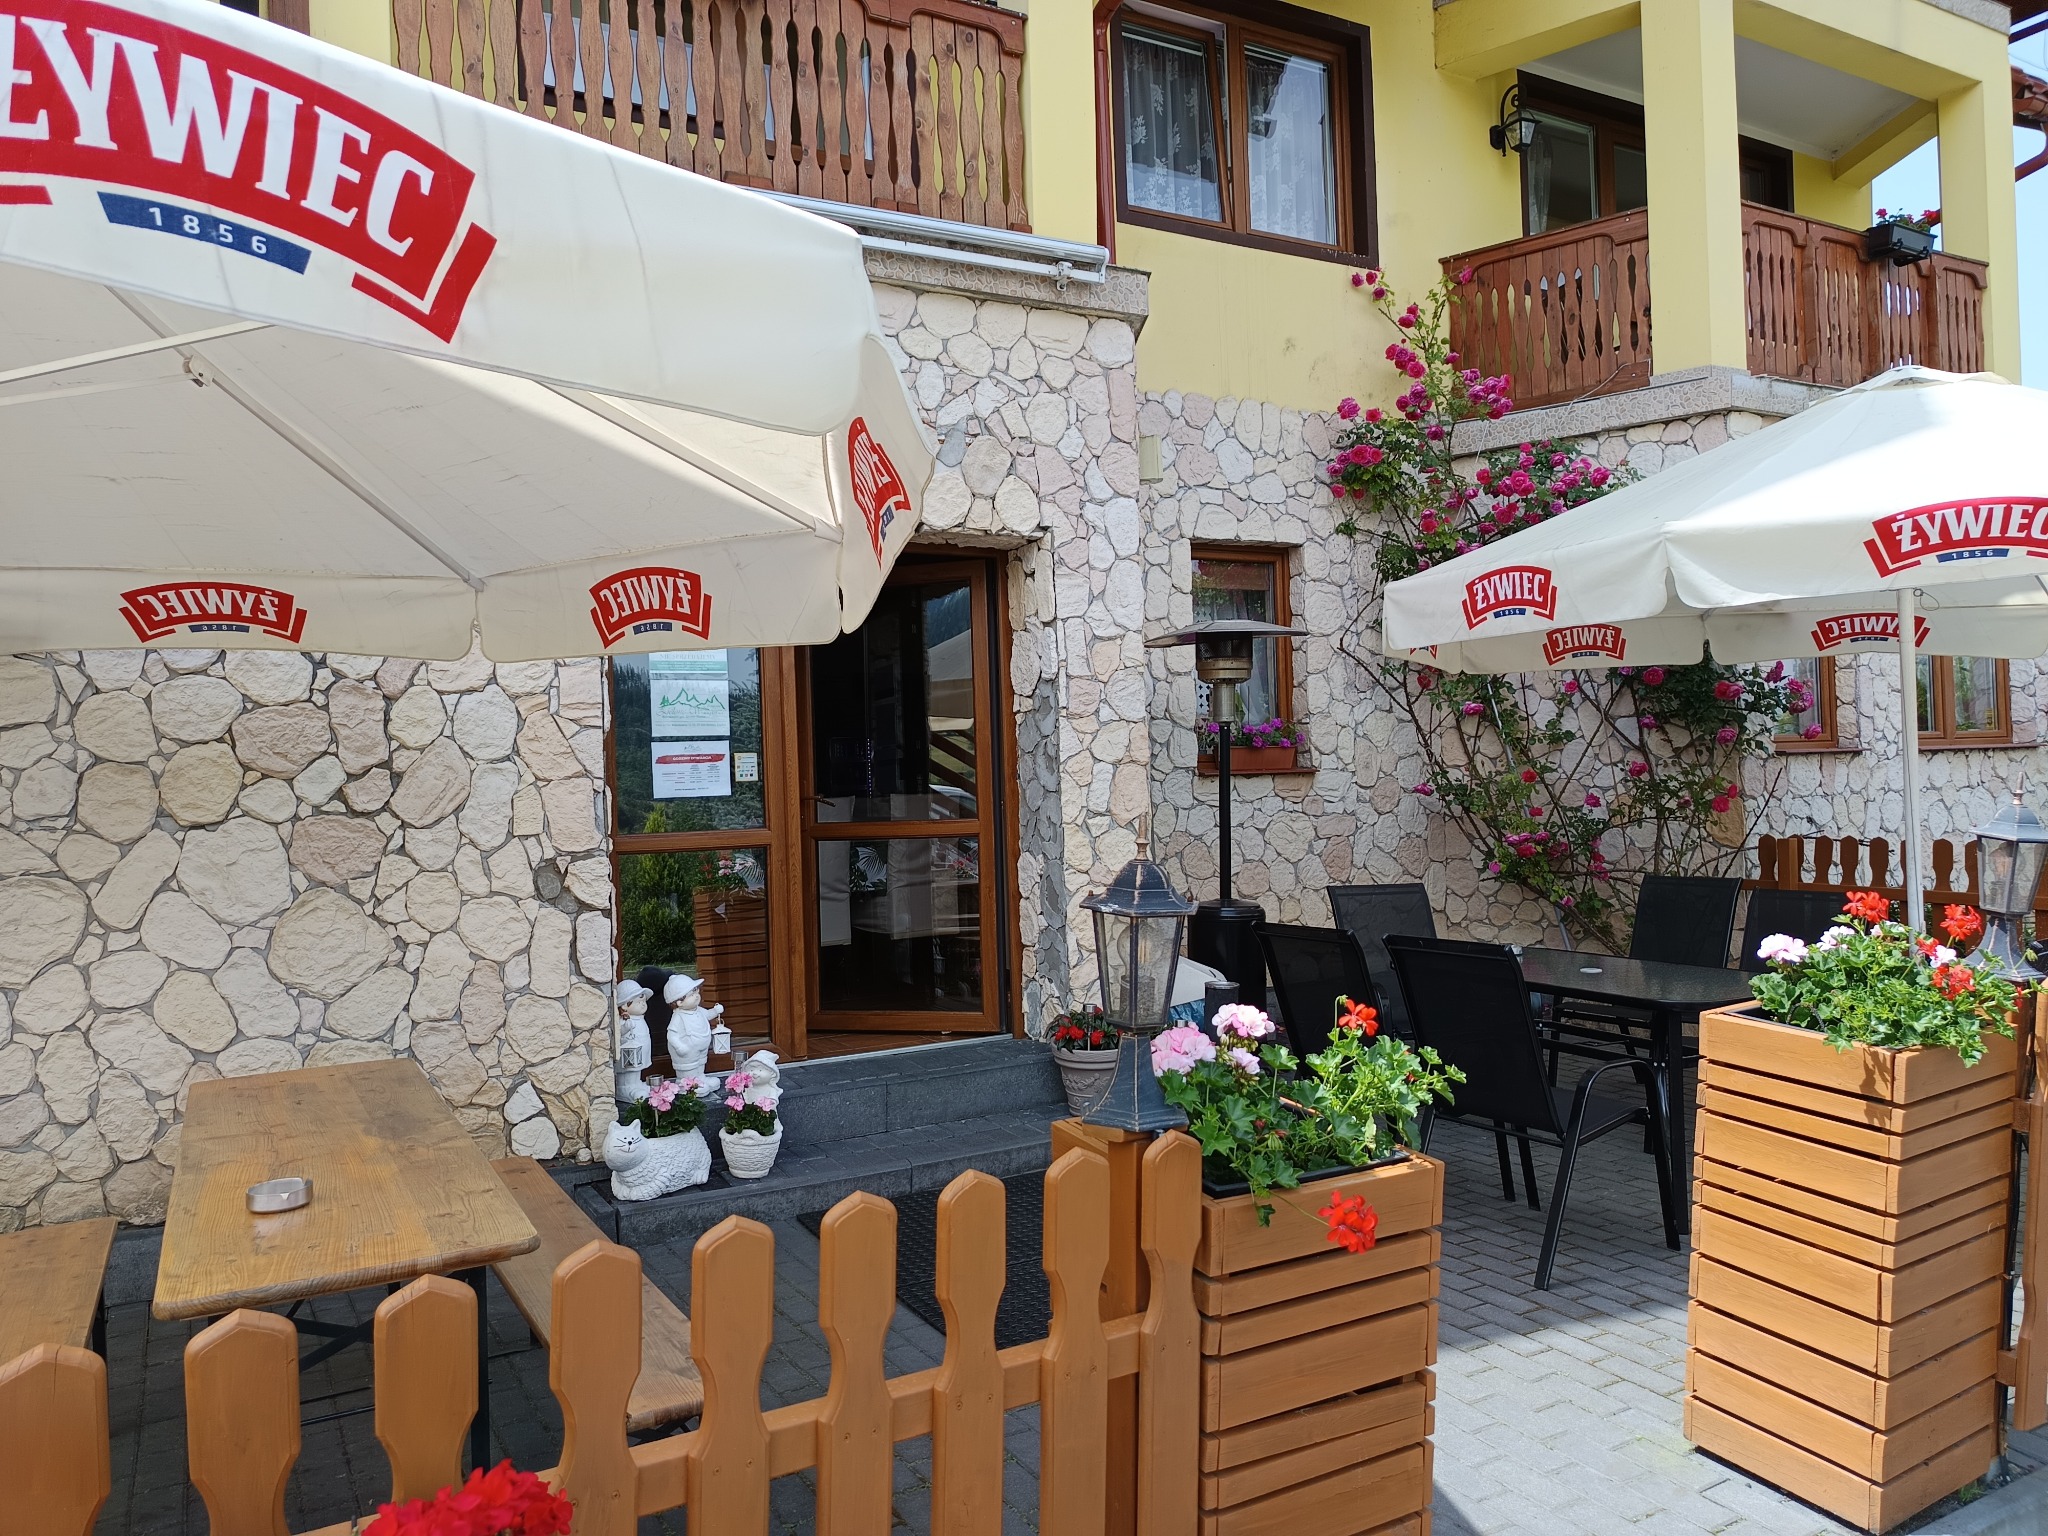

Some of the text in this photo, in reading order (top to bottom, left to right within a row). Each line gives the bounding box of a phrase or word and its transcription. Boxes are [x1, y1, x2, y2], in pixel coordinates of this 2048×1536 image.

[148, 205, 268, 256] 1856
[1951, 549, 1994, 560] 1856
[1473, 571, 1545, 611] ŻYWIEC
